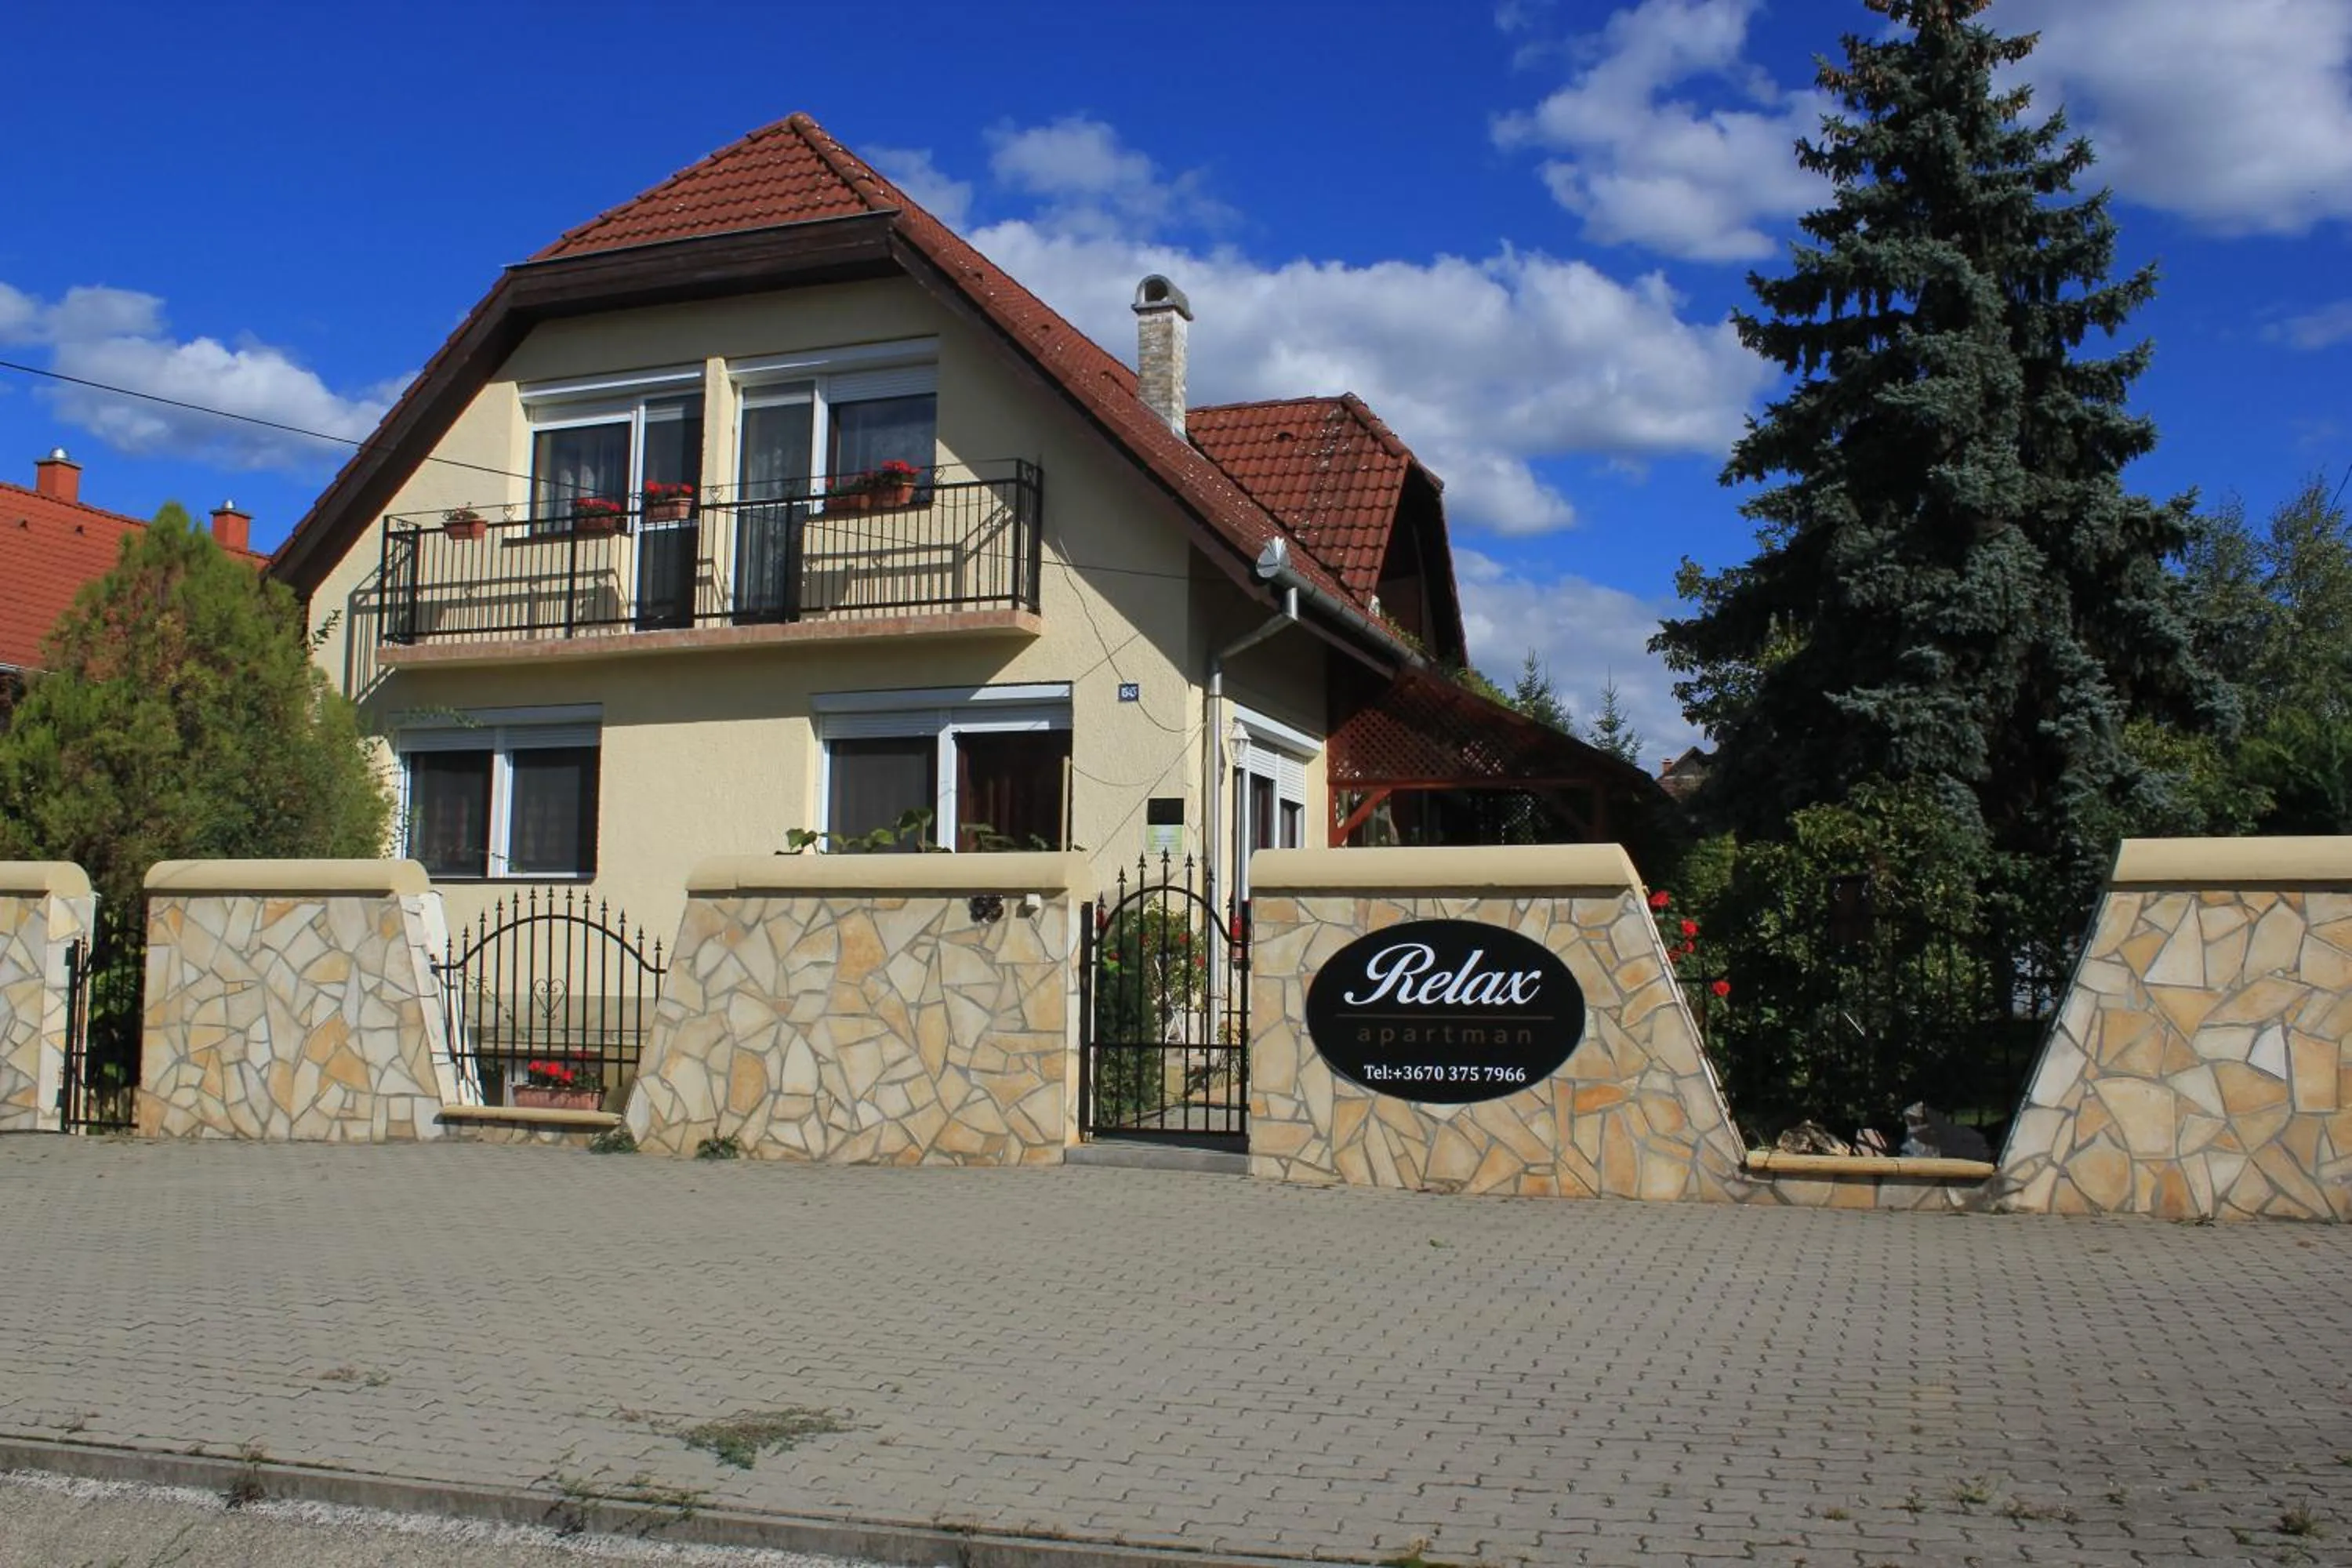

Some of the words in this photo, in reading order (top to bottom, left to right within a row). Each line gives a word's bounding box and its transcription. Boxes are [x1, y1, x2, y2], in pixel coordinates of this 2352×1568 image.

[1344, 943, 1542, 1006] Relax
[1356, 1025, 1533, 1046] apartman
[1363, 1065, 1444, 1081] Tel:+3670
[1448, 1066, 1479, 1081] 375
[1484, 1067, 1526, 1082] 7966
